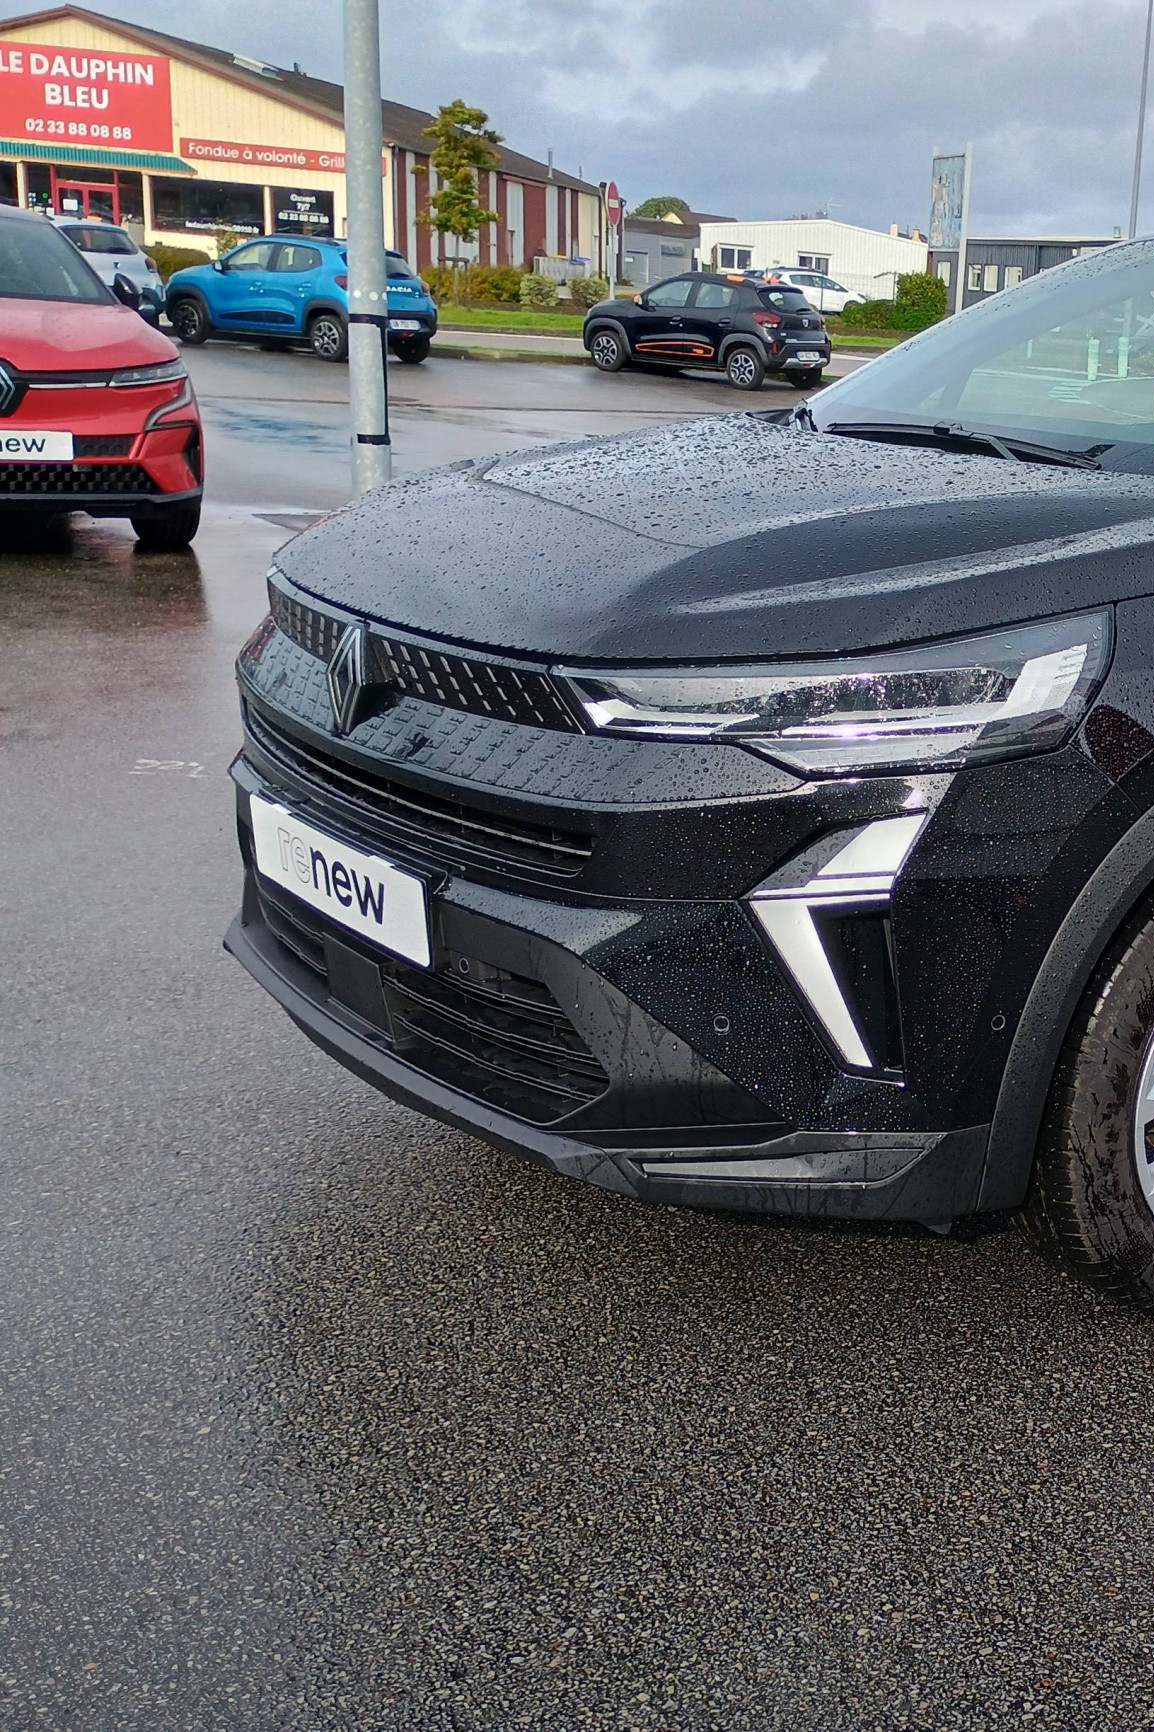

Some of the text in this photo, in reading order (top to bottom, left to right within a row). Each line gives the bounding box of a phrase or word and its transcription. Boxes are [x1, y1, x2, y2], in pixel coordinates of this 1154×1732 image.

[0, 50, 154, 86] LE DAUPHIN
[44, 83, 109, 110] BLEU
[25, 118, 132, 140] 02 33 88 08 88
[188, 142, 239, 159] Fondue
[243, 146, 253, 160] à
[256, 151, 306, 165] volonté
[319, 155, 346, 169] Grill
[0, 437, 46, 453] ew
[277, 827, 385, 925] renew
